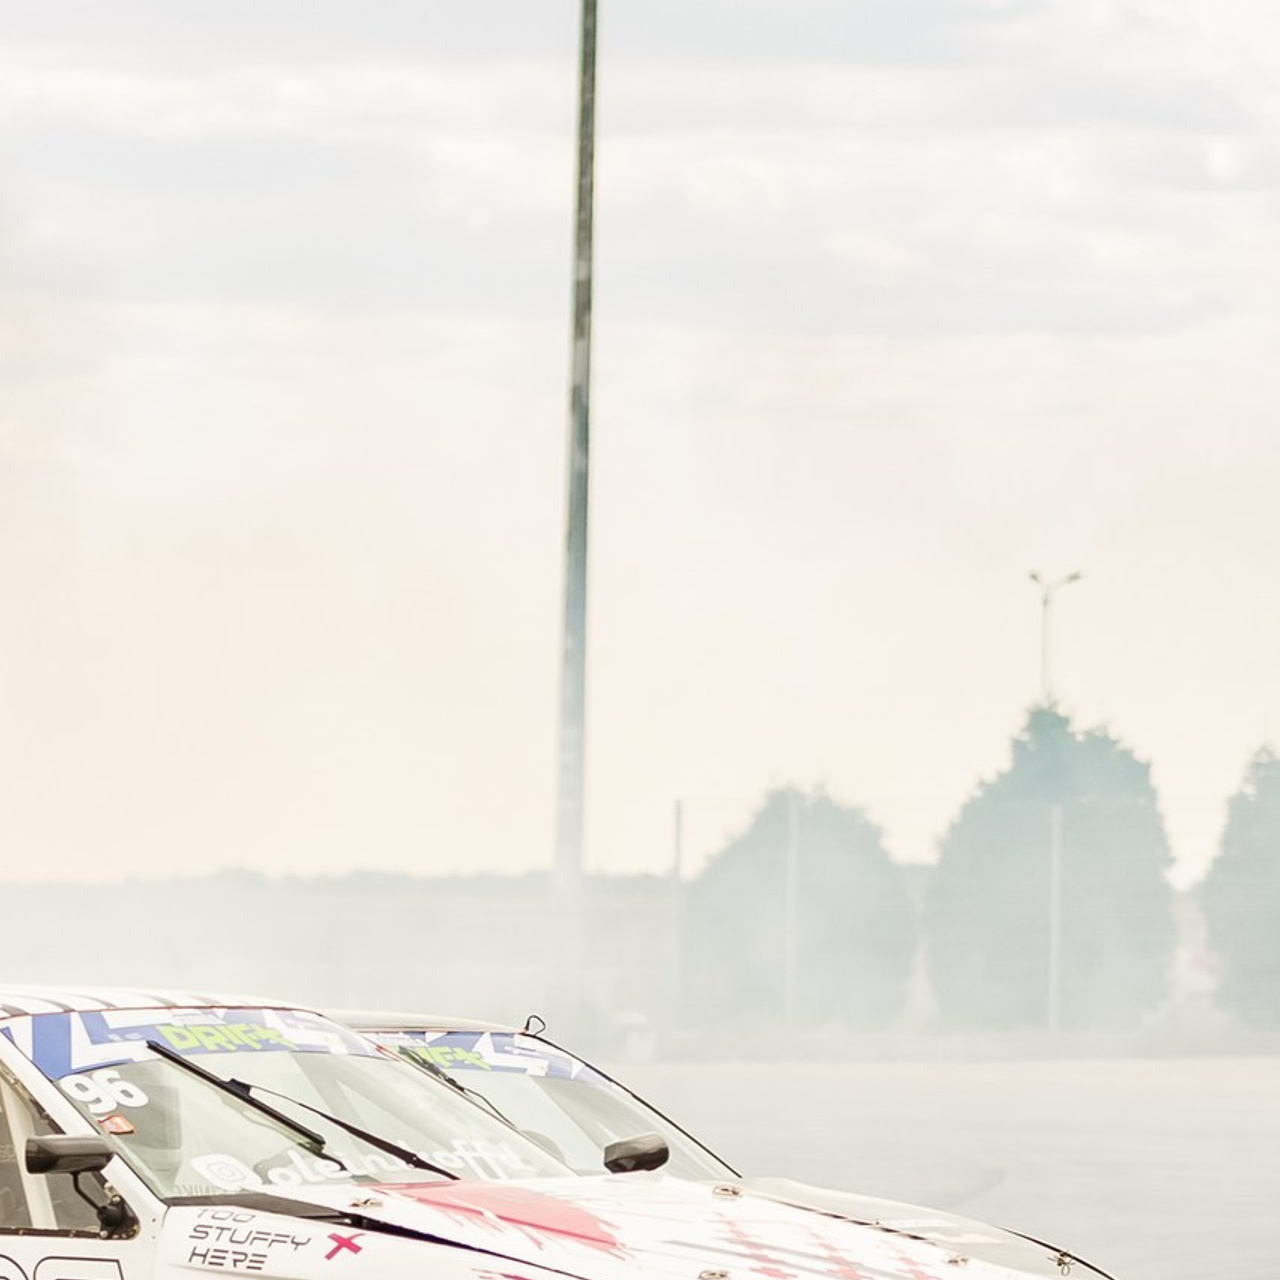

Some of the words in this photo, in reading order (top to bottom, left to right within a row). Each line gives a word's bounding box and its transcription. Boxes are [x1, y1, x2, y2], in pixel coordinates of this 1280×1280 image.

[57, 1070, 149, 1113] 96
[197, 1208, 256, 1223] TOO
[188, 1224, 312, 1251] STUFFY
[188, 1246, 268, 1271] HERE
